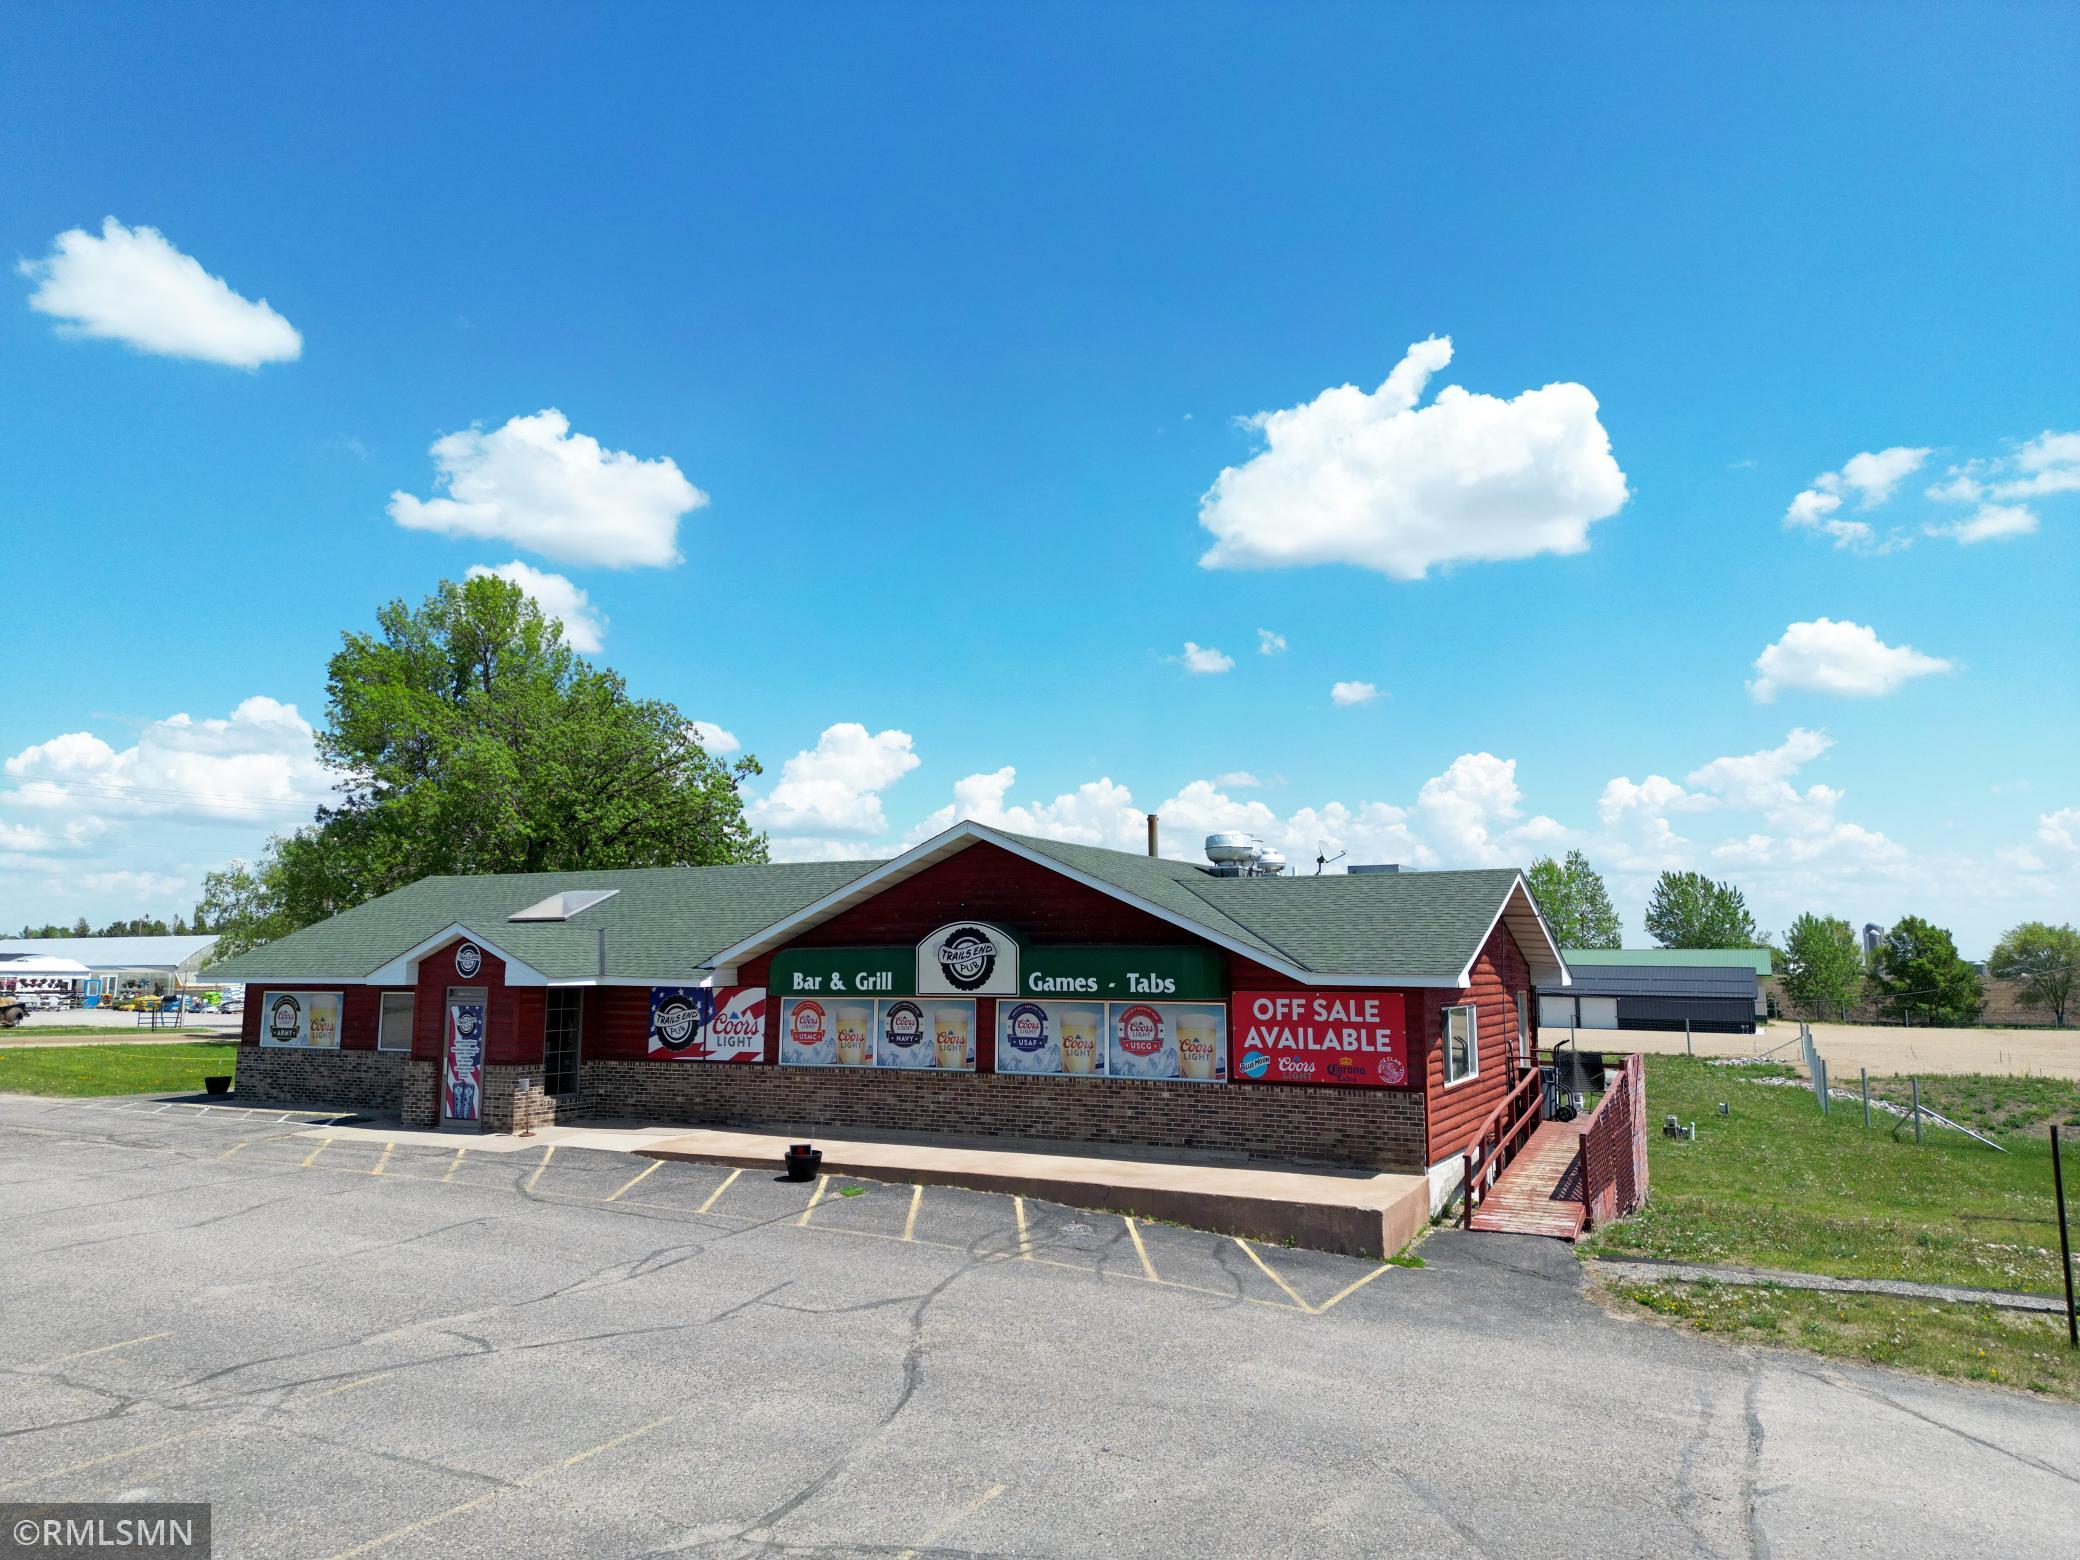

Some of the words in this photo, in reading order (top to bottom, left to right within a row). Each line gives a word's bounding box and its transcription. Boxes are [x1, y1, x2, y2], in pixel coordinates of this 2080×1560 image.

[942, 949, 972, 961] TRAILS
[973, 945, 993, 956] END
[960, 961, 980, 972] PUB
[793, 972, 822, 990] Bar
[830, 972, 846, 990] &
[855, 972, 892, 991] Grill
[1029, 972, 1098, 992] Games
[1127, 973, 1176, 993] Tabs
[1253, 998, 1306, 1021] OFF
[1313, 999, 1380, 1023] SALE
[311, 1018, 334, 1031] Coors
[657, 1014, 680, 1025] TRAILS
[681, 1011, 698, 1020] END
[712, 1013, 759, 1035] Coors
[800, 1015, 818, 1025] Coors
[896, 1016, 915, 1026] Coors
[1017, 1019, 1039, 1030] Coors
[670, 1026, 686, 1036] PUB
[1130, 1022, 1153, 1033] Coors
[717, 1036, 752, 1047] LIGHT
[838, 1029, 865, 1042] Coors
[937, 1032, 965, 1045] Coors
[1063, 1035, 1094, 1049] Coors
[1244, 1026, 1392, 1052] AVAILABLE
[1130, 1042, 1152, 1050] USCG
[1180, 1039, 1213, 1053] Coors
[1066, 1049, 1090, 1057] LIGHT
[1184, 1053, 1210, 1061] LIGHT
[1240, 1063, 1255, 1073] BLUE
[1254, 1057, 1271, 1067] MOON
[1279, 1056, 1316, 1073] Coors
[1327, 1063, 1366, 1075] Corona
[1283, 1072, 1313, 1080] LIGHT
